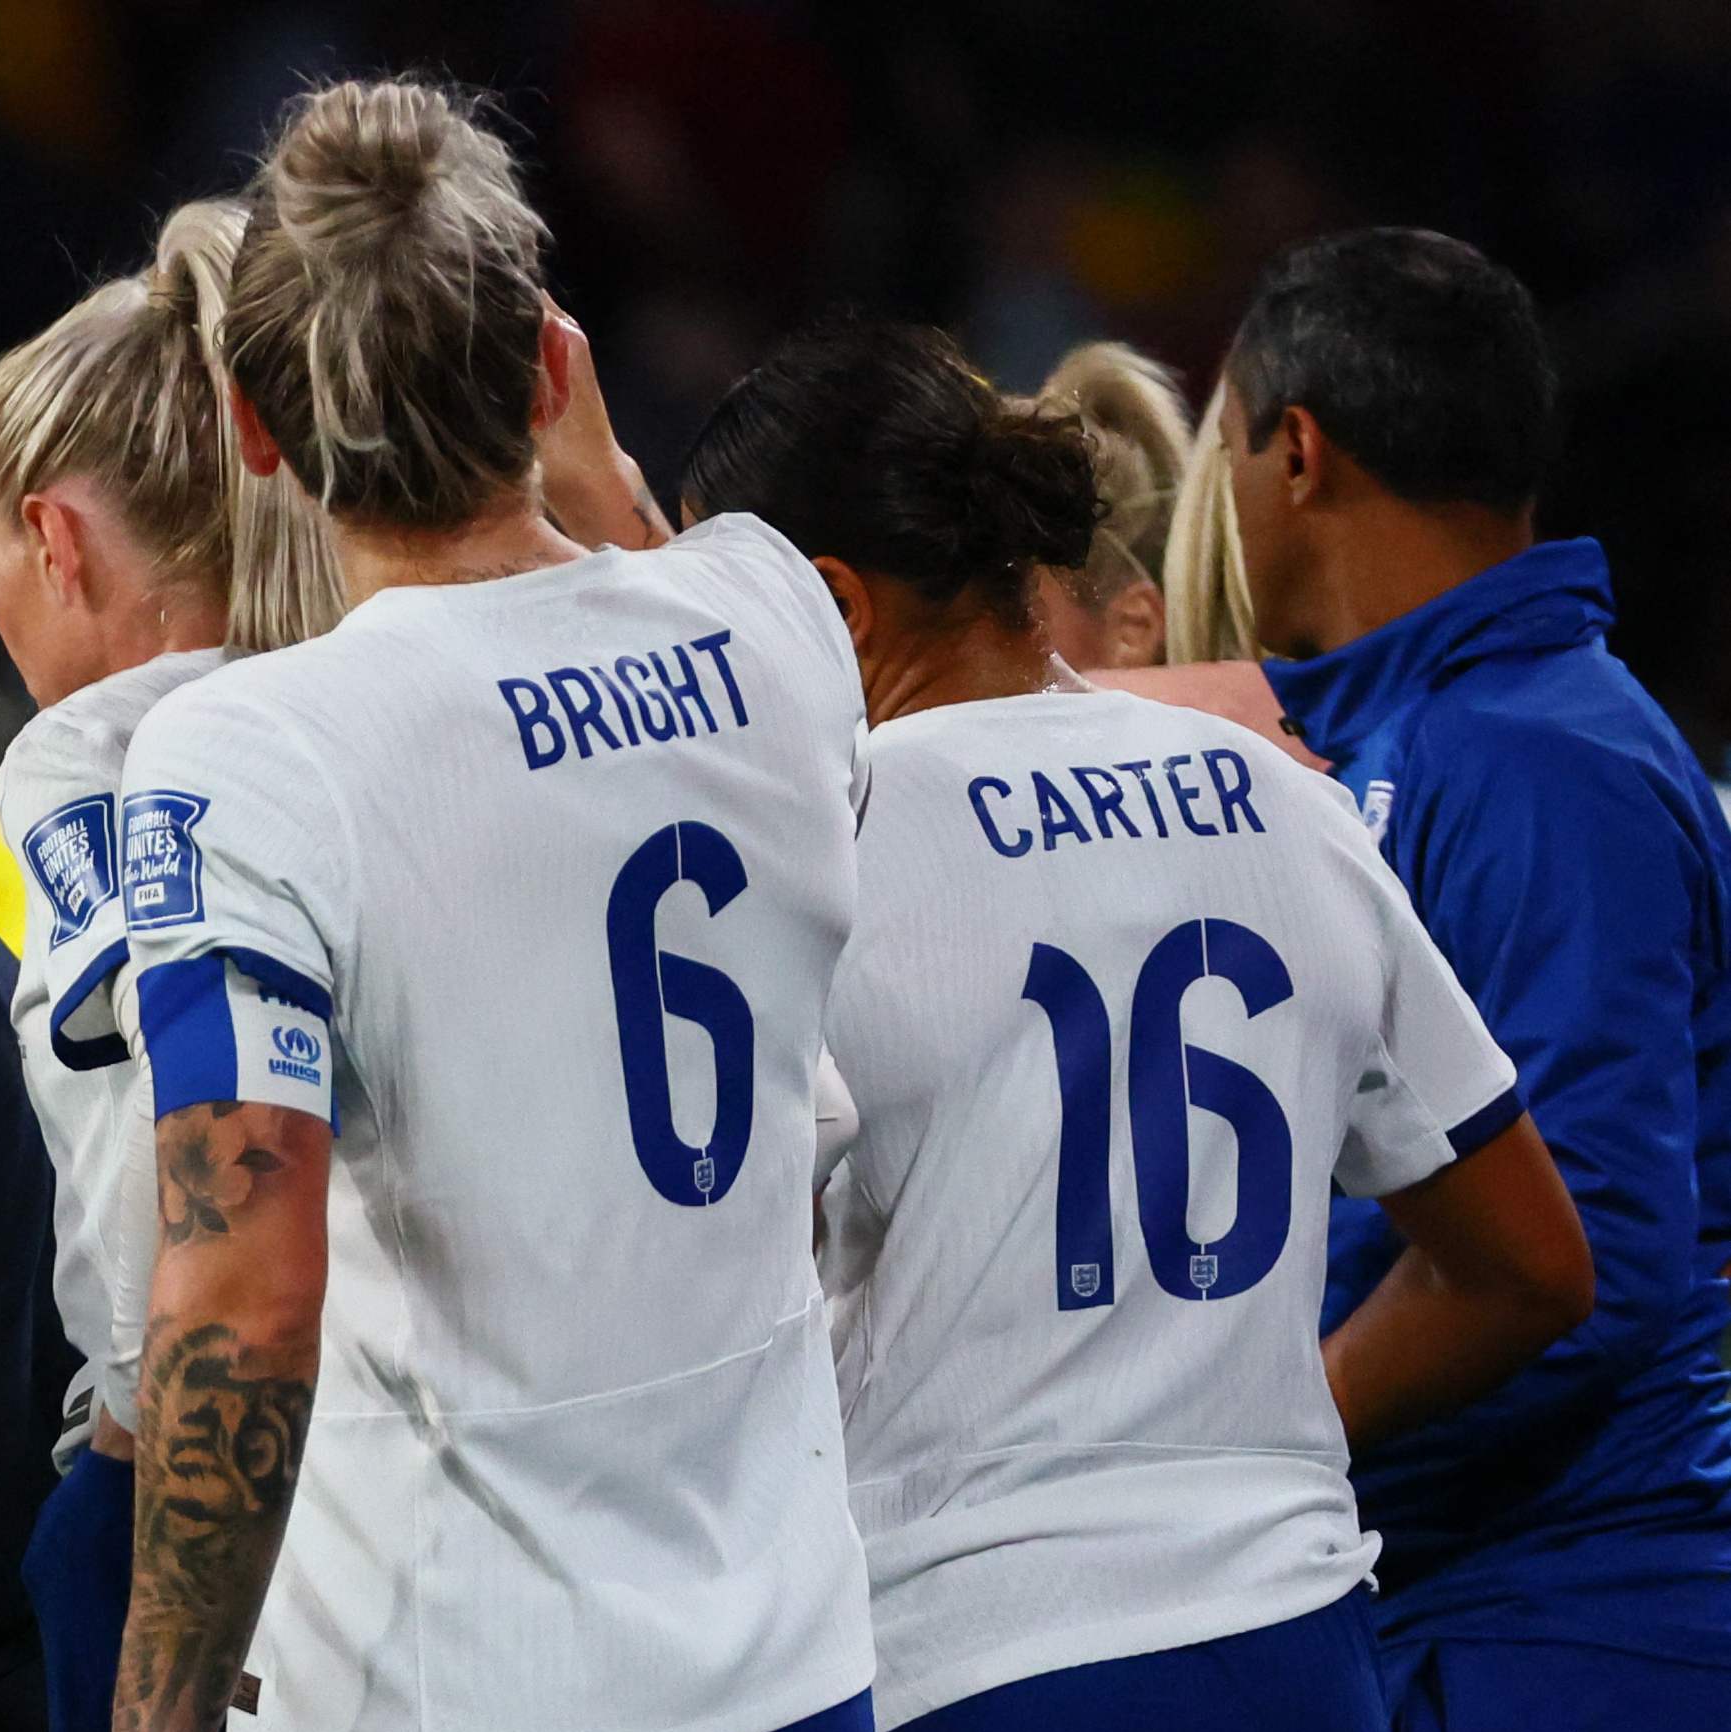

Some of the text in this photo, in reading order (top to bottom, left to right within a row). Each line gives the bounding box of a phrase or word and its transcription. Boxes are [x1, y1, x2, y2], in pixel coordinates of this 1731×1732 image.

[498, 629, 750, 770] BRIGHT
[128, 809, 172, 836] FOOTBALL
[968, 748, 1266, 858] CARTER
[37, 817, 88, 864] FOOTBALL
[43, 831, 90, 885] UNITES
[126, 828, 178, 862] UNITES
[140, 852, 181, 882] World
[139, 888, 161, 902] FIFA
[606, 820, 755, 1208] 6
[1022, 917, 1294, 1313] 16
